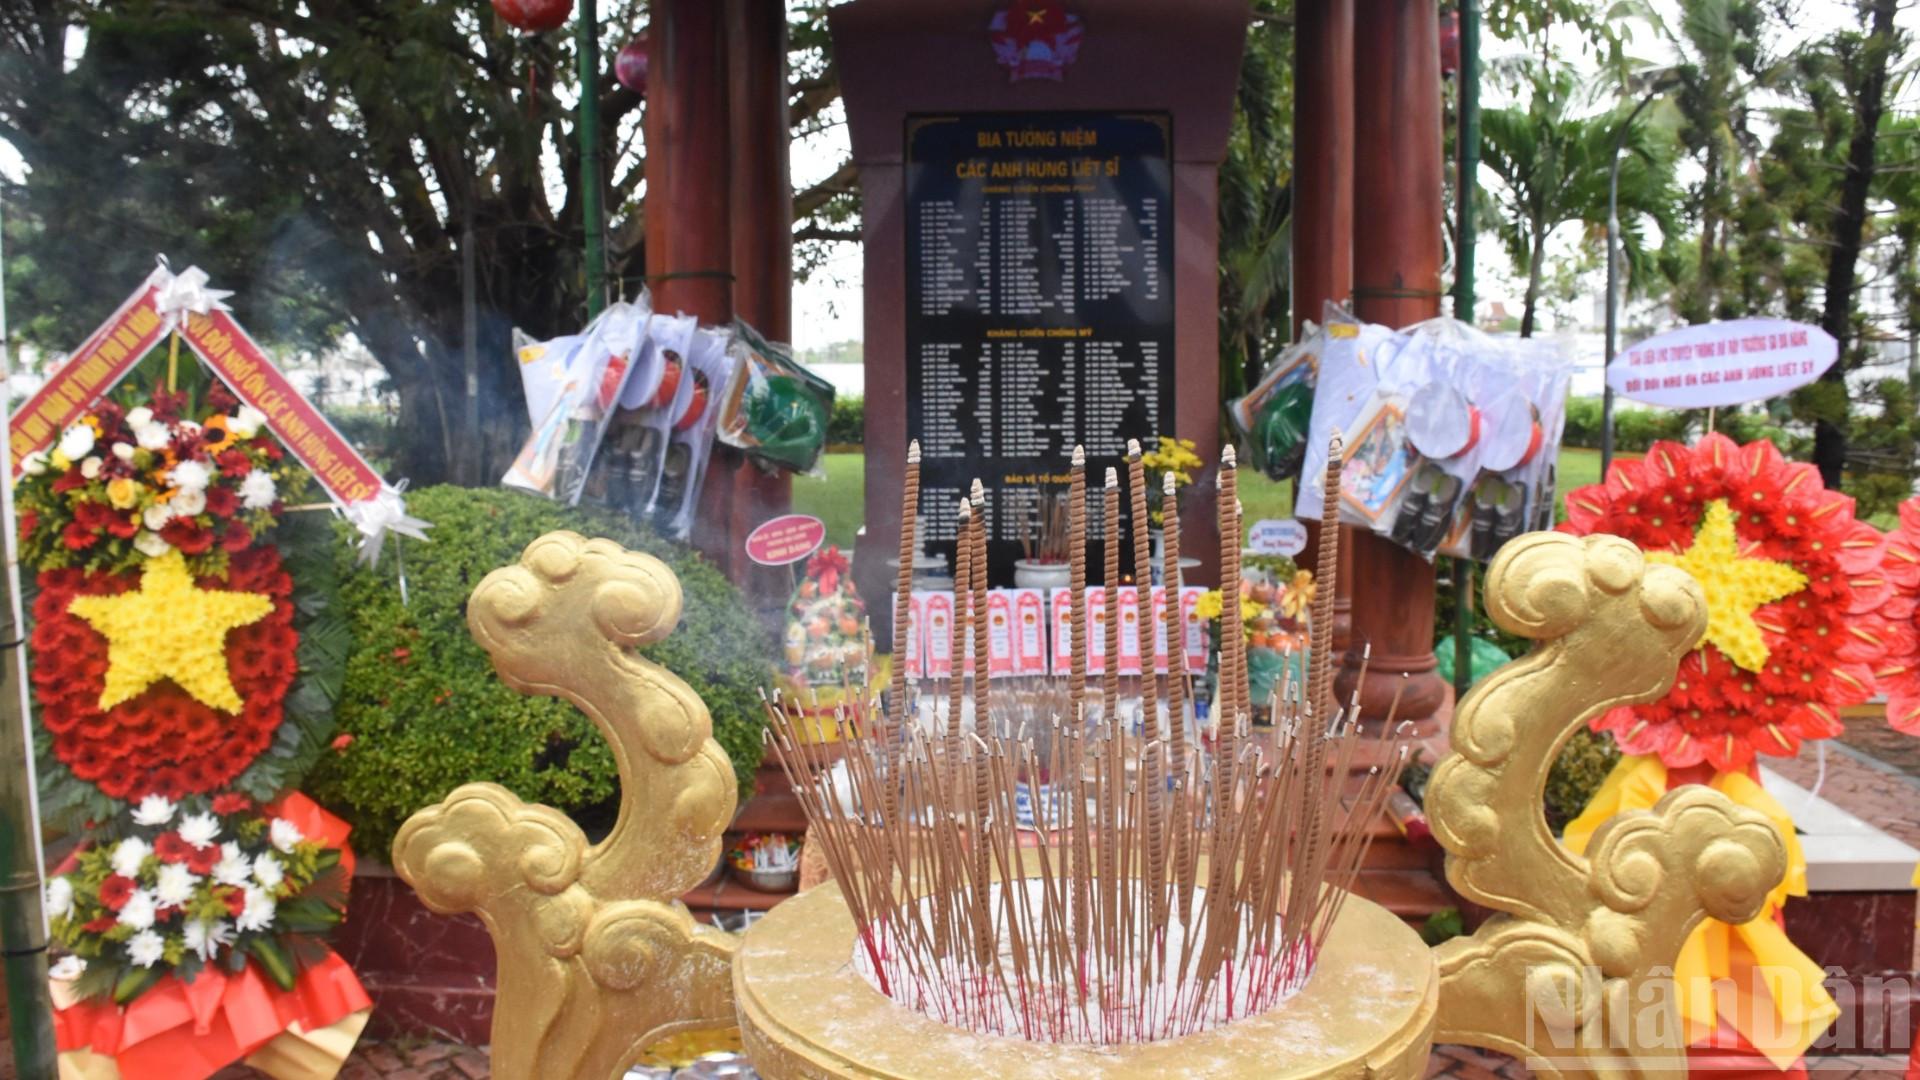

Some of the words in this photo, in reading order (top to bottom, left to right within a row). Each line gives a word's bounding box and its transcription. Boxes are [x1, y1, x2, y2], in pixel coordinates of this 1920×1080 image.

[978, 131, 1001, 147] BIA
[1060, 127, 1097, 150] NIỆM
[956, 159, 987, 178] CÁC
[991, 162, 1022, 178] ANH
[1072, 158, 1101, 179] LIỆT
[257, 389, 289, 419] CÁC
[277, 410, 310, 441] ANH
[298, 433, 337, 471] HÙNG
[325, 461, 357, 490] LIỆT
[1051, 473, 1072, 484] QUỐ
